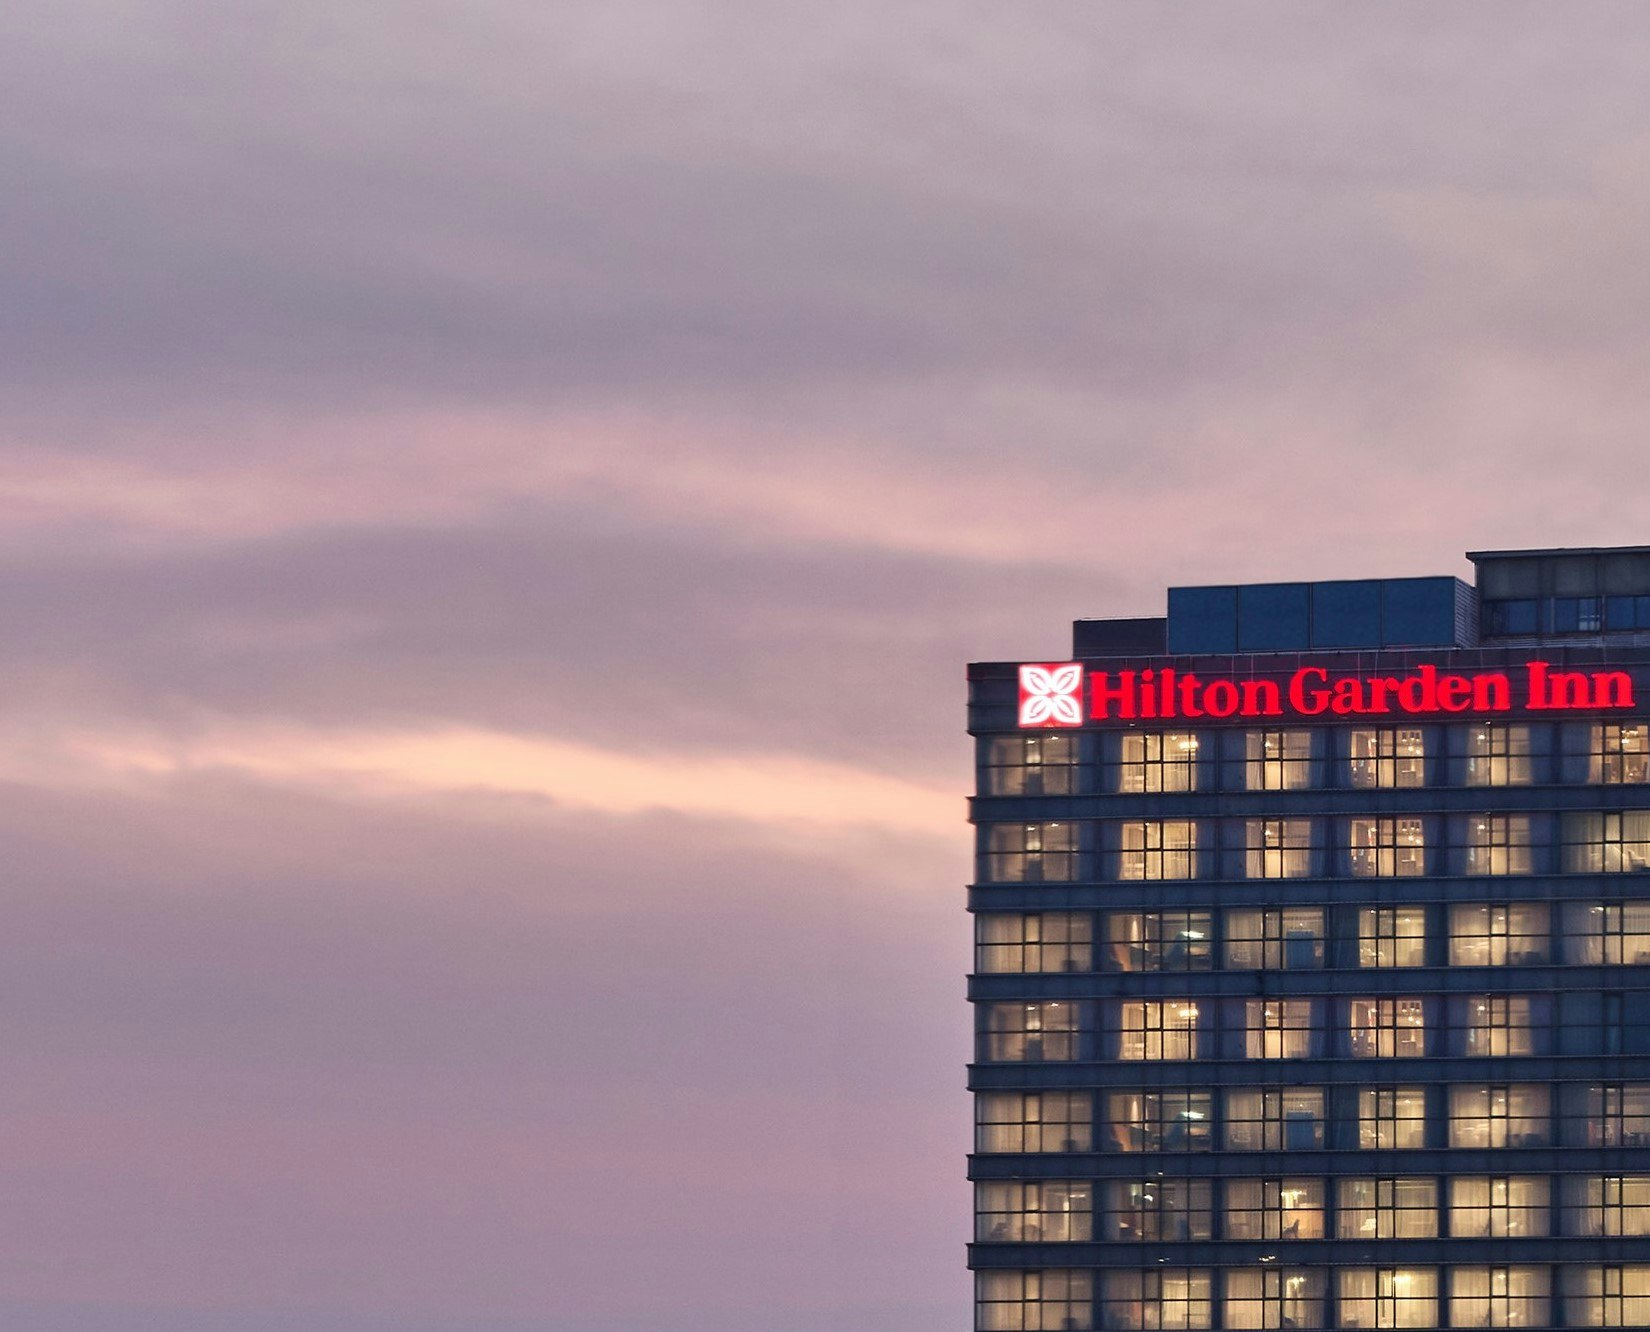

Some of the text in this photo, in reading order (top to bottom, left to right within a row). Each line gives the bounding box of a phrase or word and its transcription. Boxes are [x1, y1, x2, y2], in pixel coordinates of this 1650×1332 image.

[1089, 661, 1636, 720] Hilton Garden Inn
